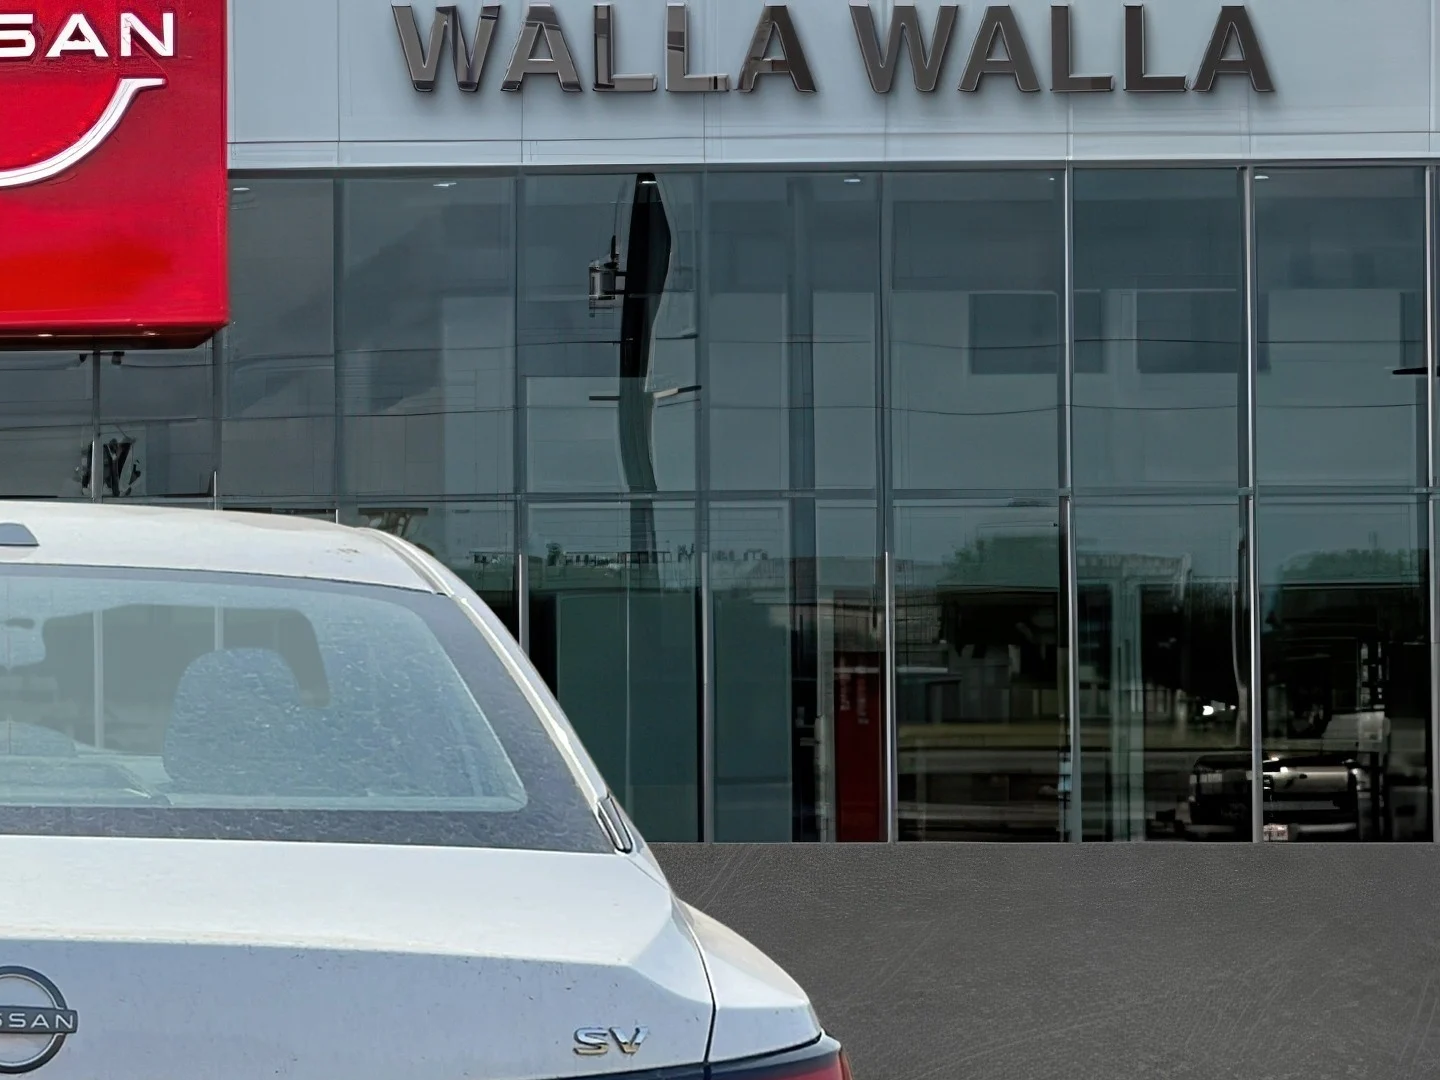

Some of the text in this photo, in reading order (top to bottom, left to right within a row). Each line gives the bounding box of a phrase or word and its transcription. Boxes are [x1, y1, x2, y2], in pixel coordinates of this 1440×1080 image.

[391, 3, 1275, 93] WALLA WALLA
[572, 1026, 650, 1056] SV
